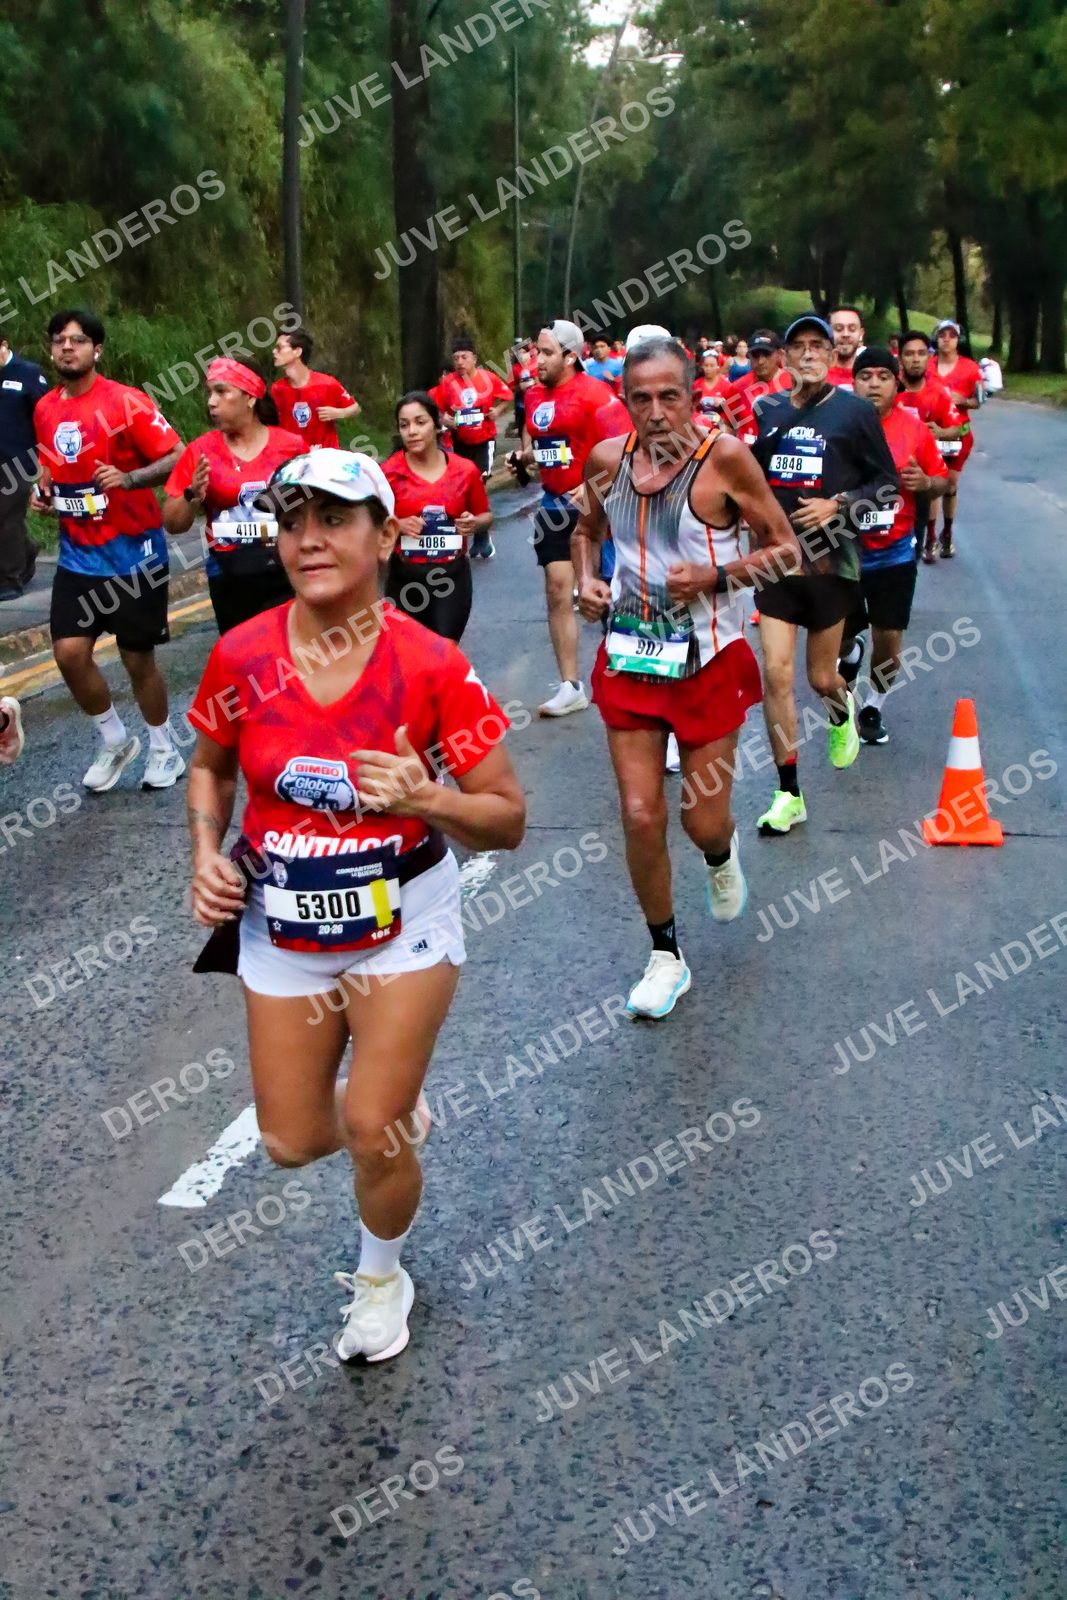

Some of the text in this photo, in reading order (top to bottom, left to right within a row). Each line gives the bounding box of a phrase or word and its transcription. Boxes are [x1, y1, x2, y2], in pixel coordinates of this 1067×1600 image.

[776, 456, 803, 471] 3848
[65, 498, 84, 510] 5113
[236, 524, 257, 536] 4111
[419, 536, 446, 548] 4086
[294, 763, 340, 777] BIMBO
[295, 776, 339, 793] Global
[296, 890, 361, 920] 5300
